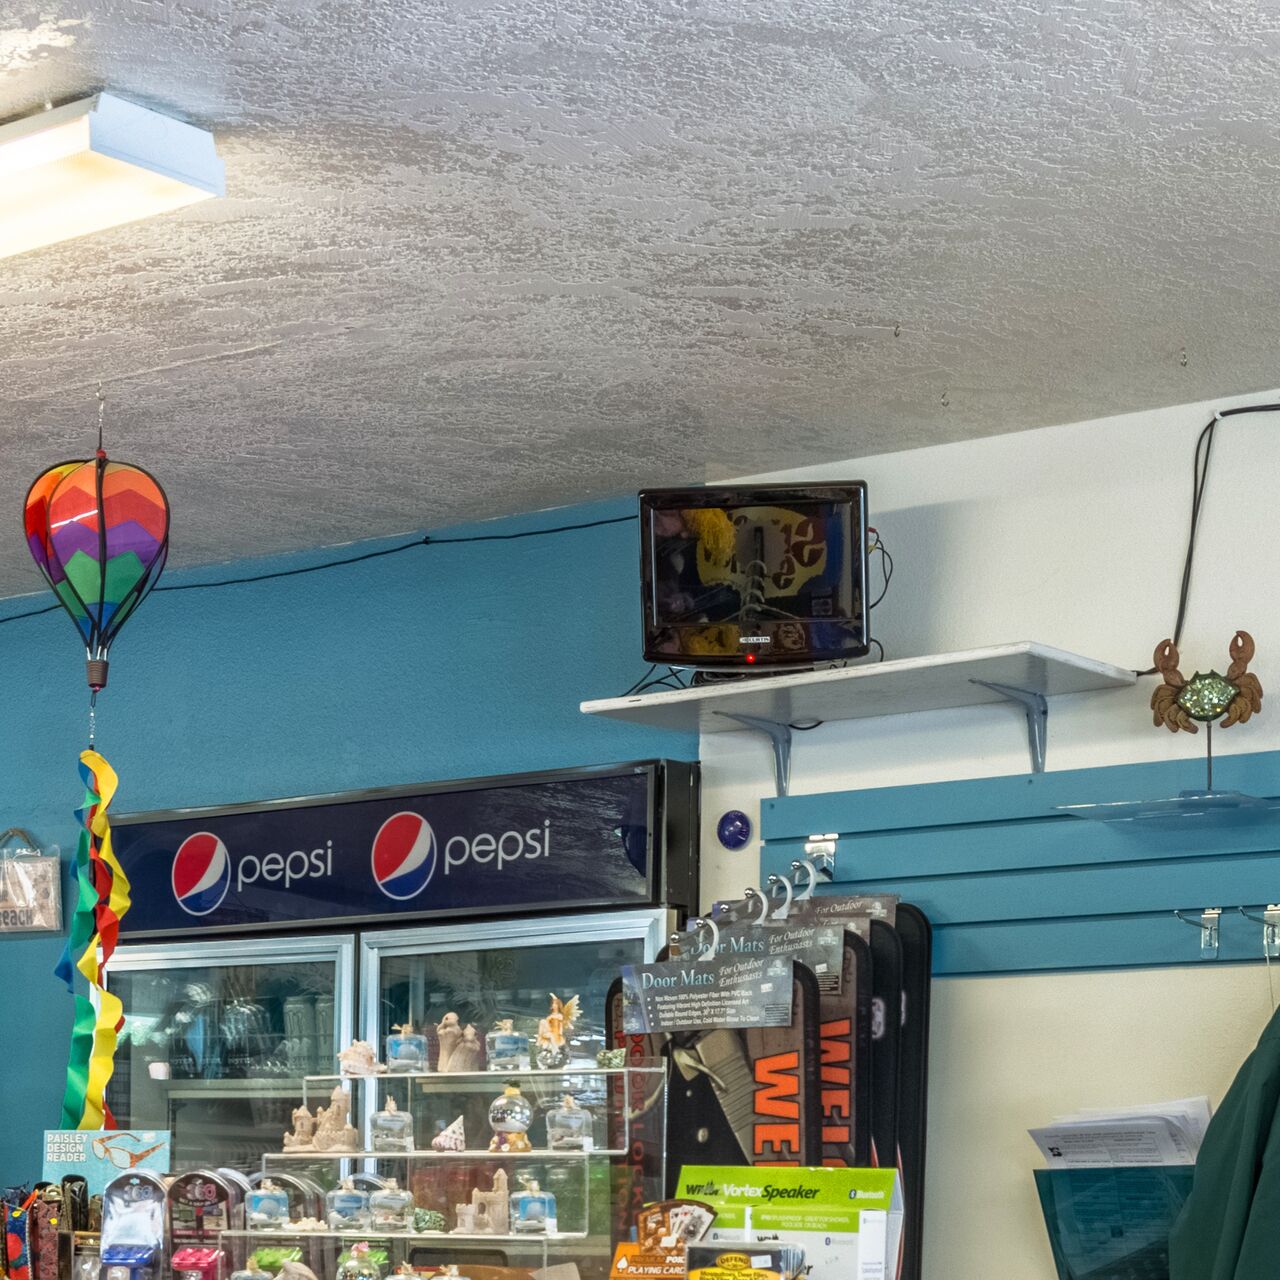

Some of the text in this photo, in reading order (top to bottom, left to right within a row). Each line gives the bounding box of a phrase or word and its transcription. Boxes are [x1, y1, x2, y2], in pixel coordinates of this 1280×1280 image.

[444, 820, 550, 876] pepsi
[237, 840, 333, 892] pepsi
[770, 927, 814, 944] For Outdoor
[730, 936, 765, 953] Mats
[720, 957, 764, 976] For Outdoor
[642, 969, 715, 989] Door Mats
[720, 970, 762, 987] Enthusiasts
[753, 1051, 800, 1166] WE
[46, 1133, 88, 1145] PAISLEY
[46, 1143, 84, 1154] DESIGN
[46, 1152, 87, 1163] READER
[723, 1183, 764, 1199] Vortex
[762, 1184, 819, 1201] Speaker
[628, 1266, 662, 1275] PLAYING
